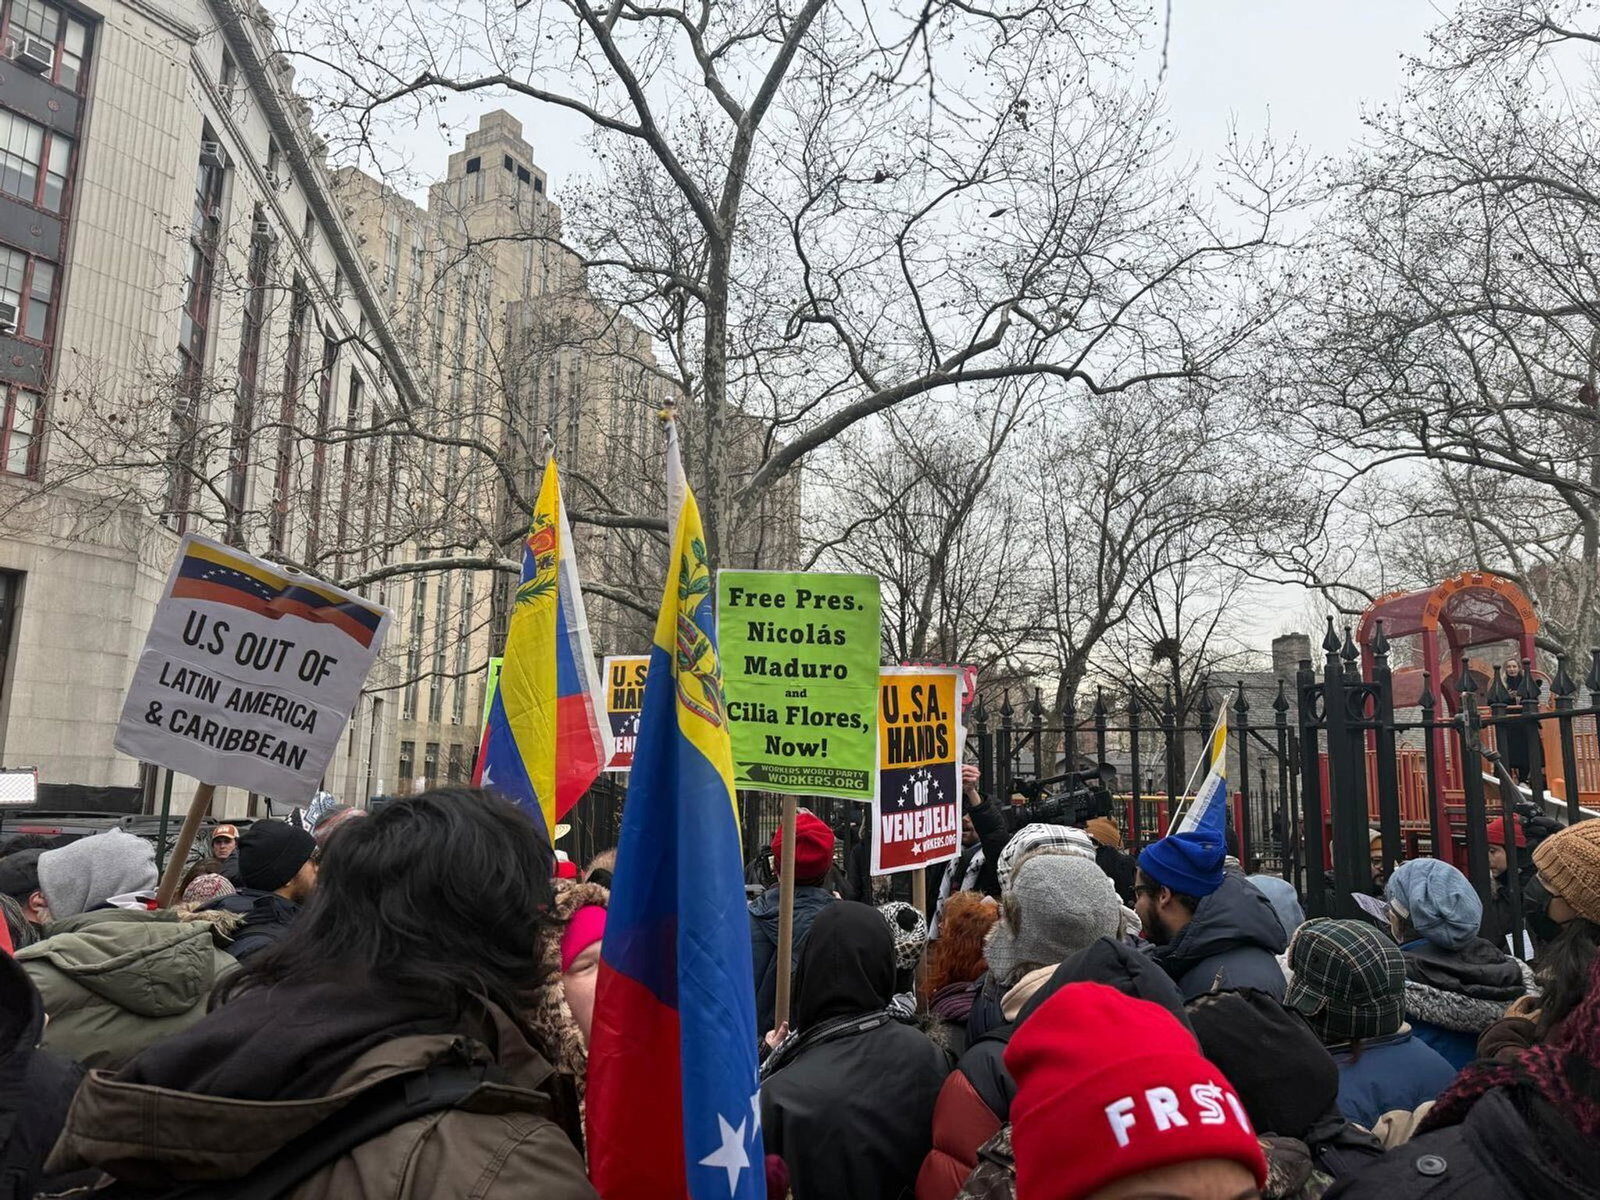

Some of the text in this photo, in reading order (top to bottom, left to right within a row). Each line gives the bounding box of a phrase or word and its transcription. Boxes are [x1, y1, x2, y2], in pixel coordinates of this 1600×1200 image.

[729, 587, 864, 611] Free Pres.
[747, 622, 846, 645] Nicolás
[182, 610, 337, 686] U.S OUT OF
[613, 665, 647, 687] U.S
[744, 656, 848, 680] Maduro
[159, 662, 318, 734] LATIN AMERICA
[785, 688, 807, 699] and
[727, 702, 779, 724] Cilia
[785, 705, 869, 733] Flores,
[145, 701, 307, 770] & CARIBBEAN
[765, 735, 828, 758] Now!
[761, 764, 865, 779] WORKERS WORLD PARTY
[768, 773, 865, 789] WORKERS.ORG
